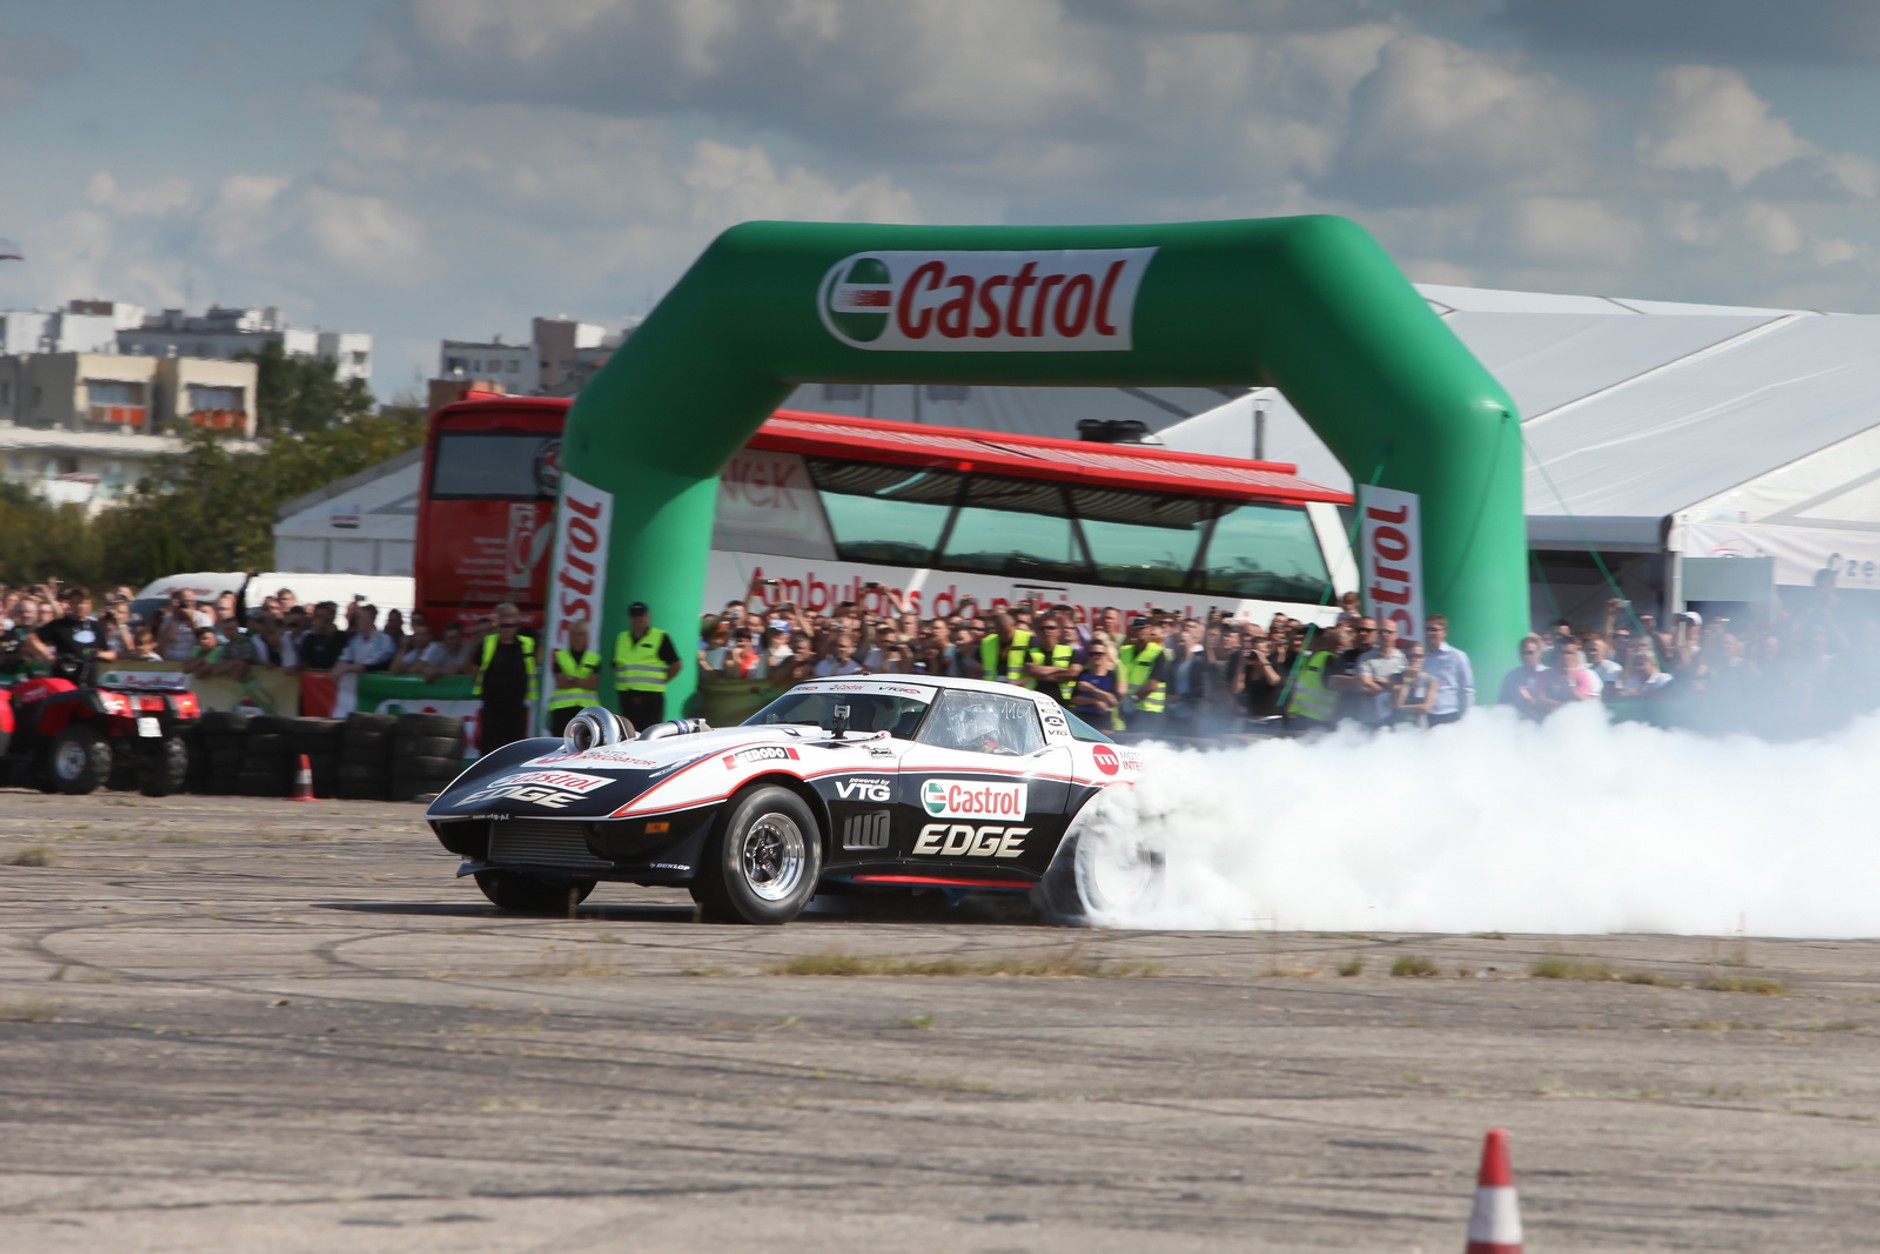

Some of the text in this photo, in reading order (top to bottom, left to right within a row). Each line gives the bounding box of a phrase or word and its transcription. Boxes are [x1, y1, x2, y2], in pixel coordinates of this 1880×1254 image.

[895, 259, 1128, 340] Castrol
[834, 781, 891, 802] VTG
[880, 778, 891, 787] by
[451, 785, 589, 809] EDGE
[948, 784, 1021, 815] Castrol
[911, 823, 1034, 858] EDGE
[655, 863, 691, 871] DUNLOP
